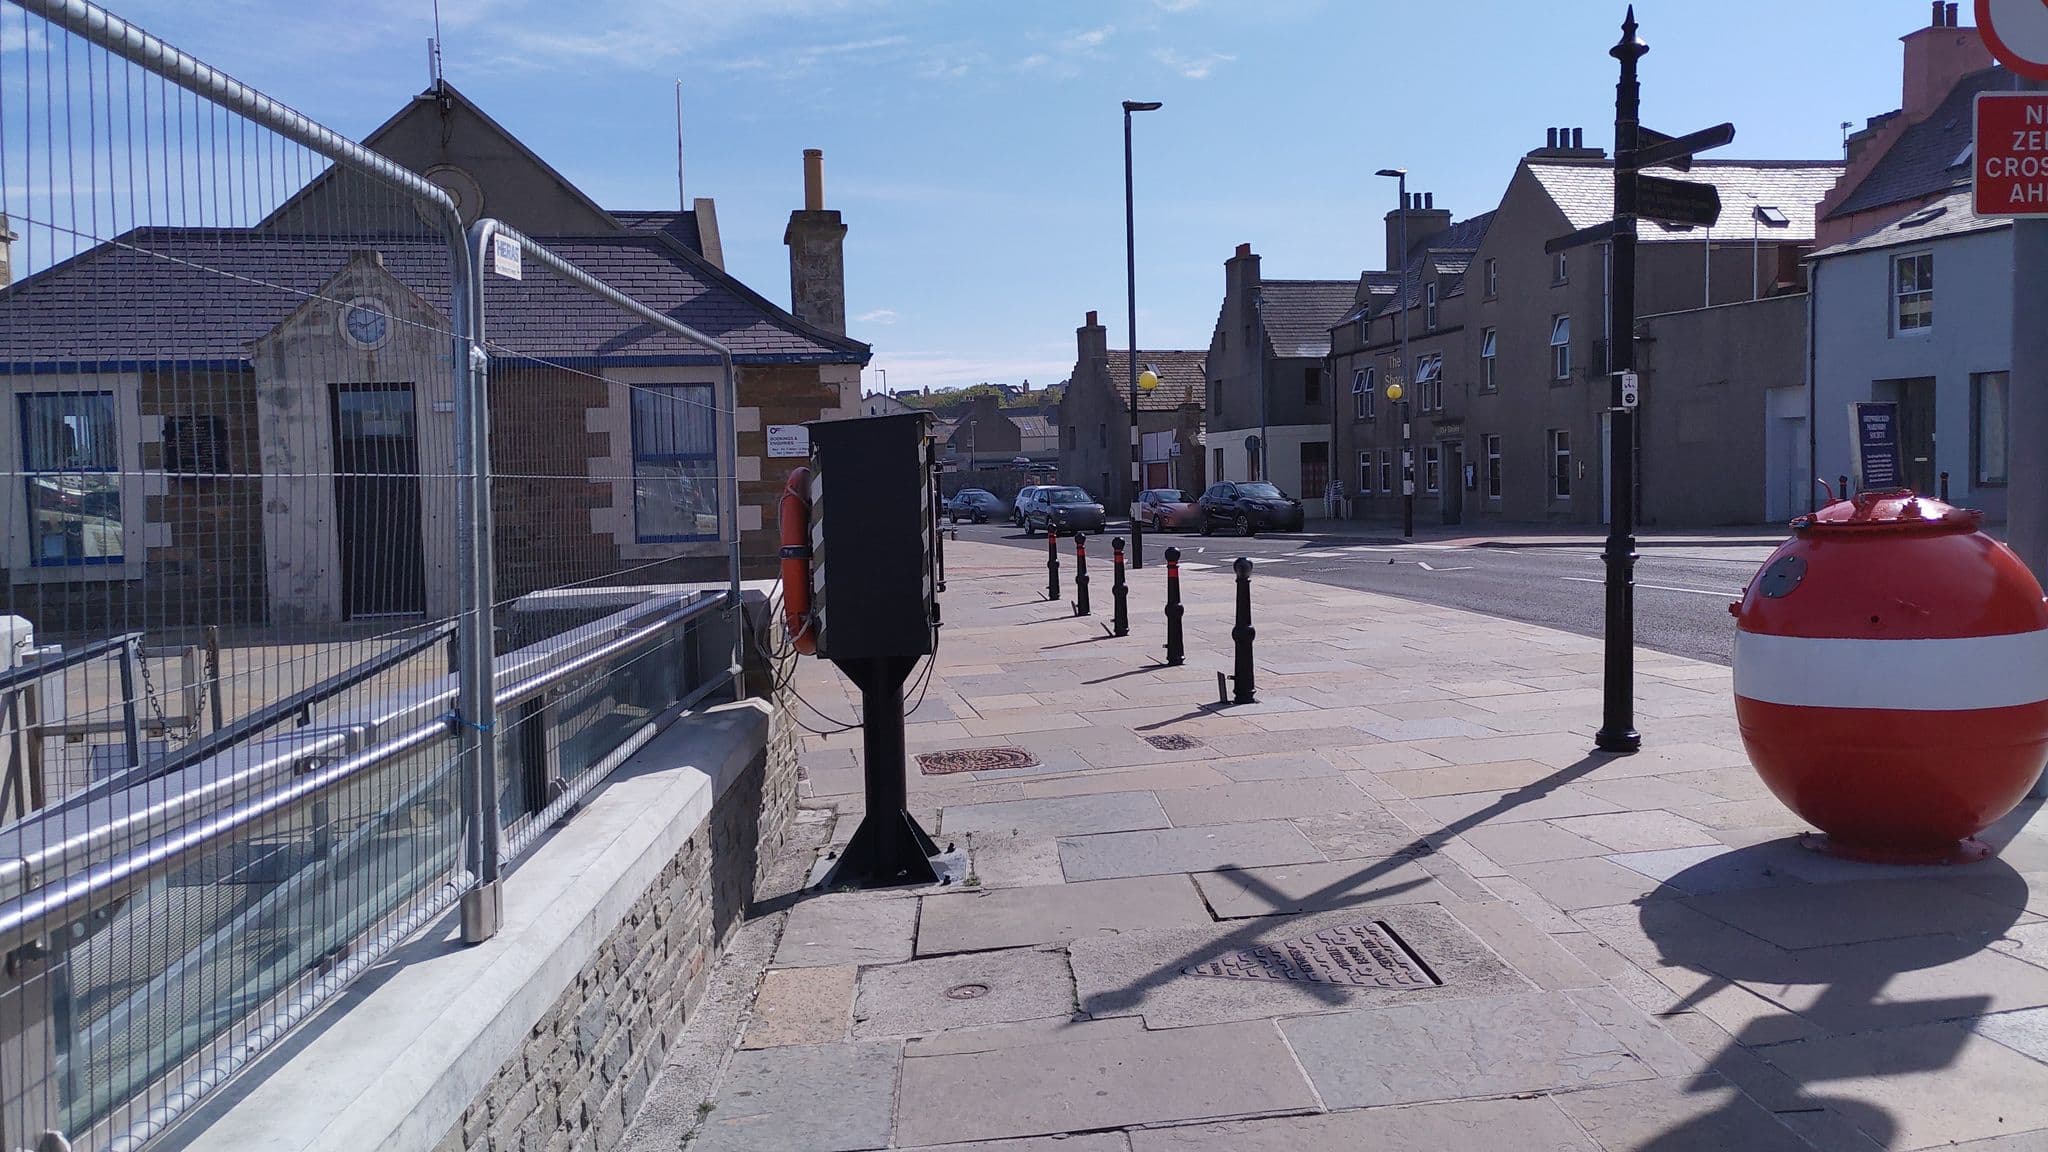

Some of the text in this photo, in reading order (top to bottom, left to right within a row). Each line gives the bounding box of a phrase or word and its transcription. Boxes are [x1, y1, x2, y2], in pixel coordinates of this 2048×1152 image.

[2026, 104, 2048, 125] N
[2013, 130, 2048, 151] ZE
[2009, 183, 2048, 203] AH
[1389, 355, 1402, 369] The
